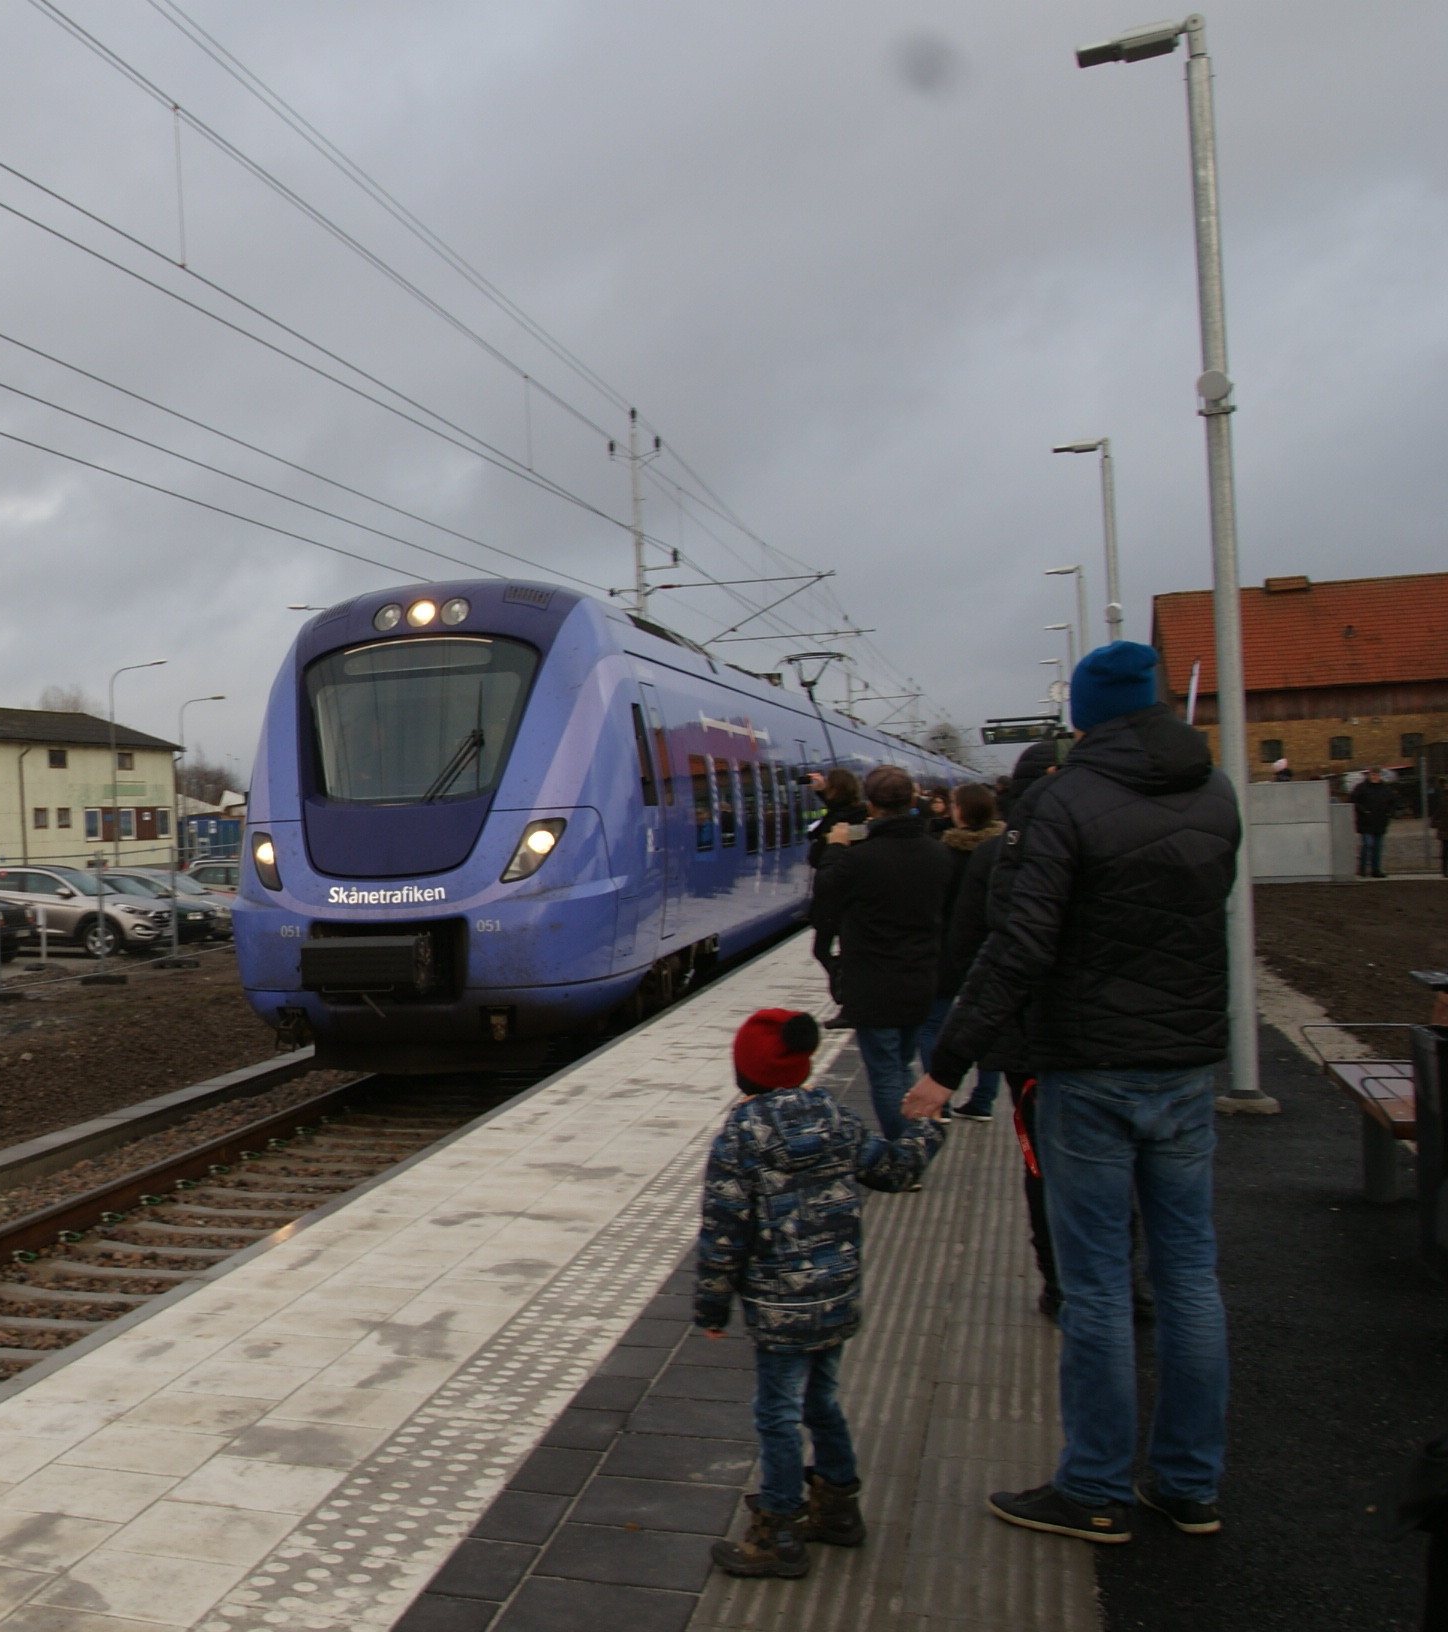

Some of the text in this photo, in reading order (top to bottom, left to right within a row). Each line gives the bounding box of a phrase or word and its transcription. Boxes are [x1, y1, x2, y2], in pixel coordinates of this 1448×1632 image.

[328, 886, 446, 905] Skånetrafiken
[280, 924, 301, 938] 051
[476, 919, 502, 933] 051
